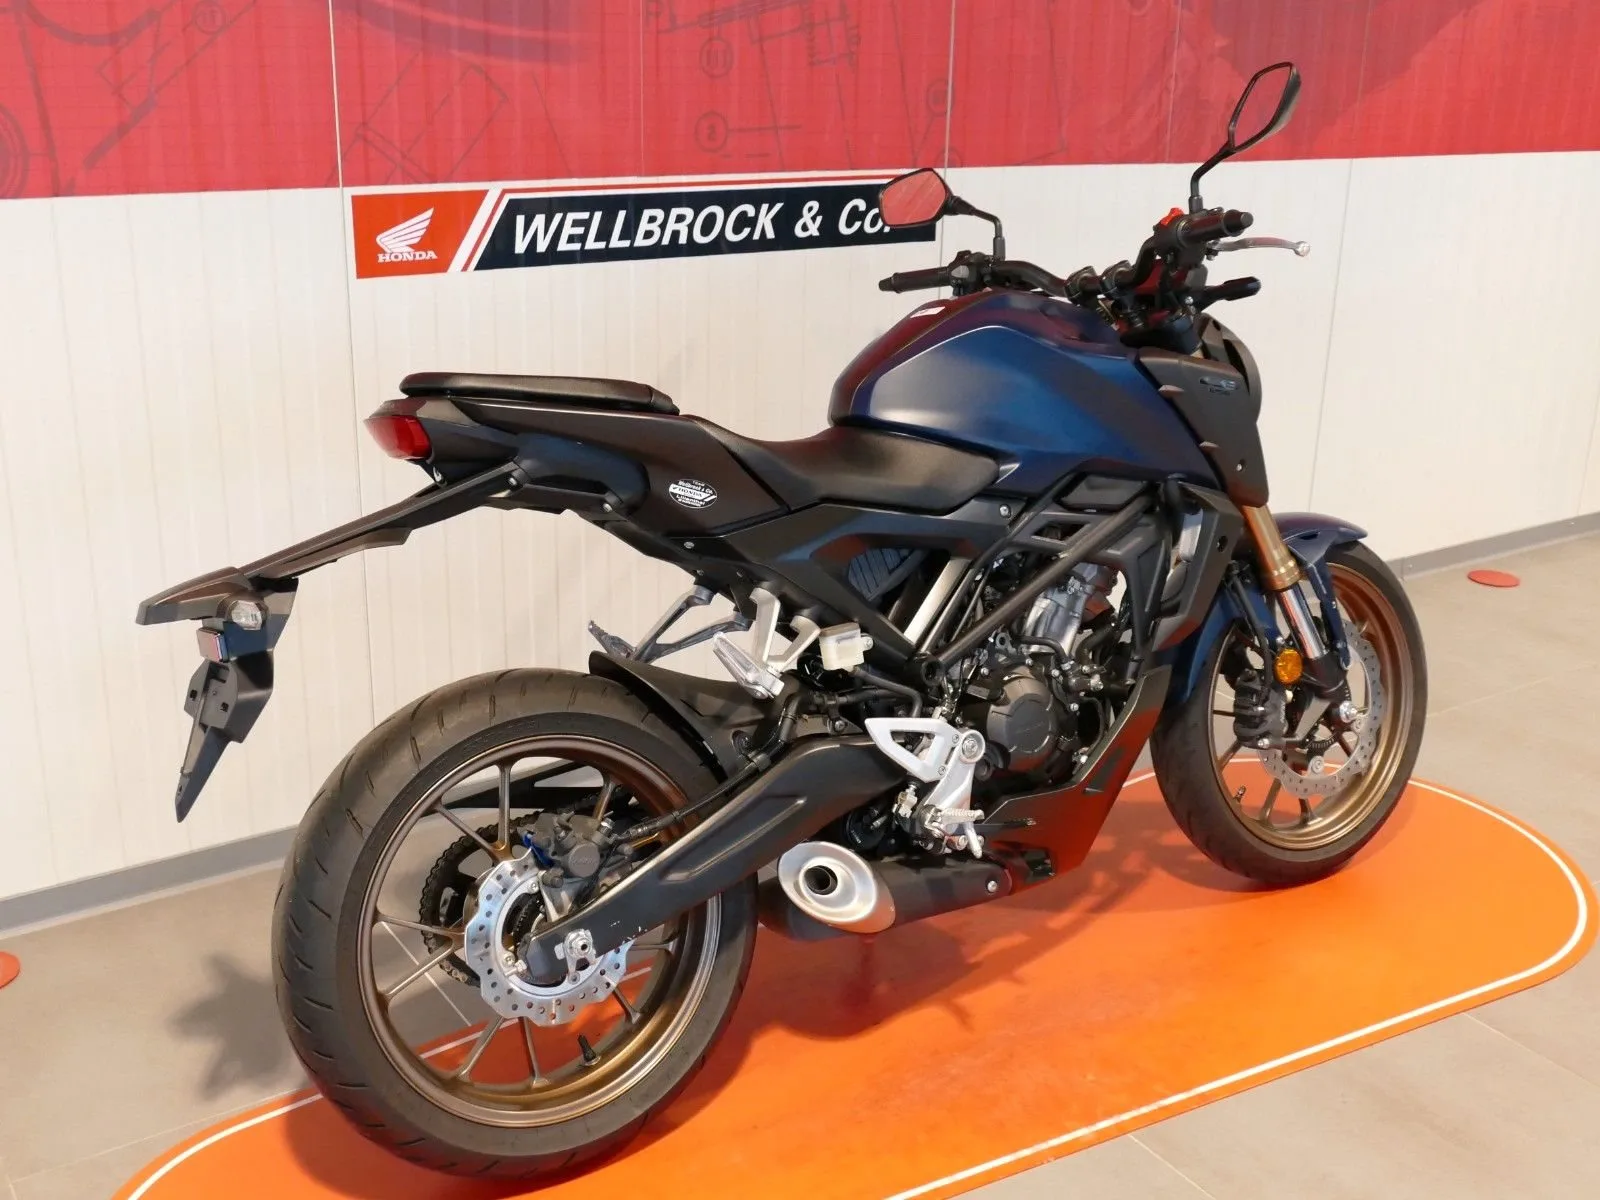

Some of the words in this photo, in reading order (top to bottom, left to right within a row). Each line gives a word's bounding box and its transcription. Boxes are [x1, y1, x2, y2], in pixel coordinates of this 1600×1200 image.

[514, 202, 784, 254] WELLBROCK
[794, 200, 823, 238] &
[838, 198, 891, 235] Co.
[377, 250, 438, 263] HONDA
